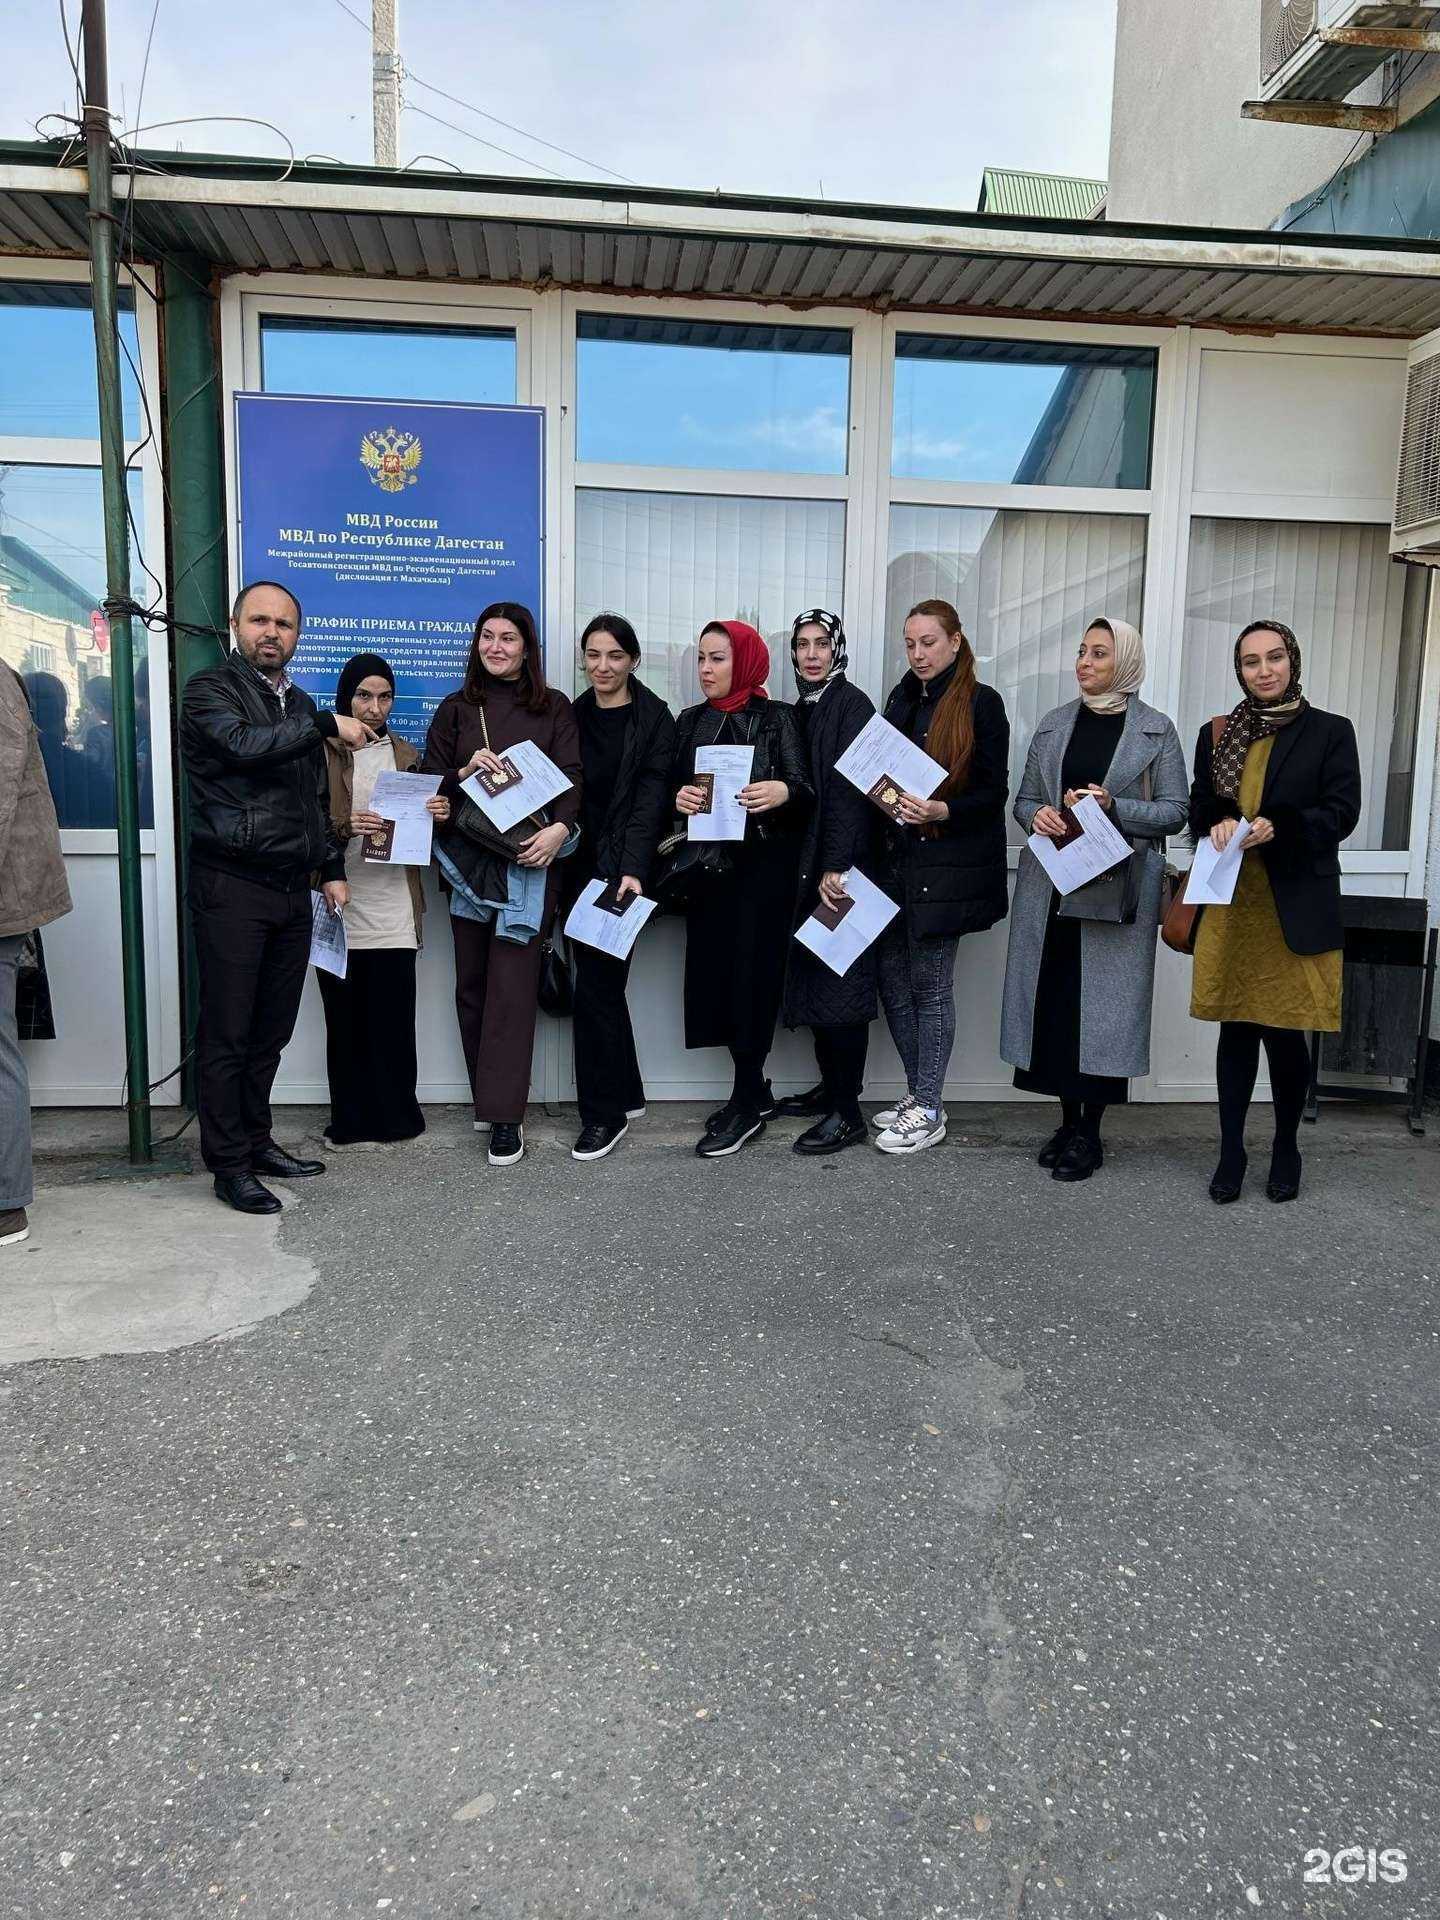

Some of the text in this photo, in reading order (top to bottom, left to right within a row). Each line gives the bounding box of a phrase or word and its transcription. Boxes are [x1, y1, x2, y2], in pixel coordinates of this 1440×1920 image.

[346, 513, 439, 529] МВД России
[279, 528, 504, 550] МВД по Республике Дагестан
[267, 549, 516, 568] Межрайонный регистрационно-экзаменационный отдел
[371, 563, 392, 573] МВД
[405, 565, 456, 576] Республике
[456, 567, 496, 577] Дагестан
[335, 572, 391, 582] (дислокация
[400, 575, 451, 585] Махачкала)
[305, 616, 359, 629] ГРАФИК
[361, 618, 416, 631] ПРИЕМА
[299, 633, 352, 642] оставлению
[353, 635, 426, 645] государственных
[428, 638, 451, 647] услуг
[389, 647, 423, 656] средств
[432, 649, 471, 657] прицепо
[291, 655, 326, 663] едению
[413, 659, 464, 668] управления
[286, 666, 330, 675] средством
[391, 718, 408, 726] 9.00
